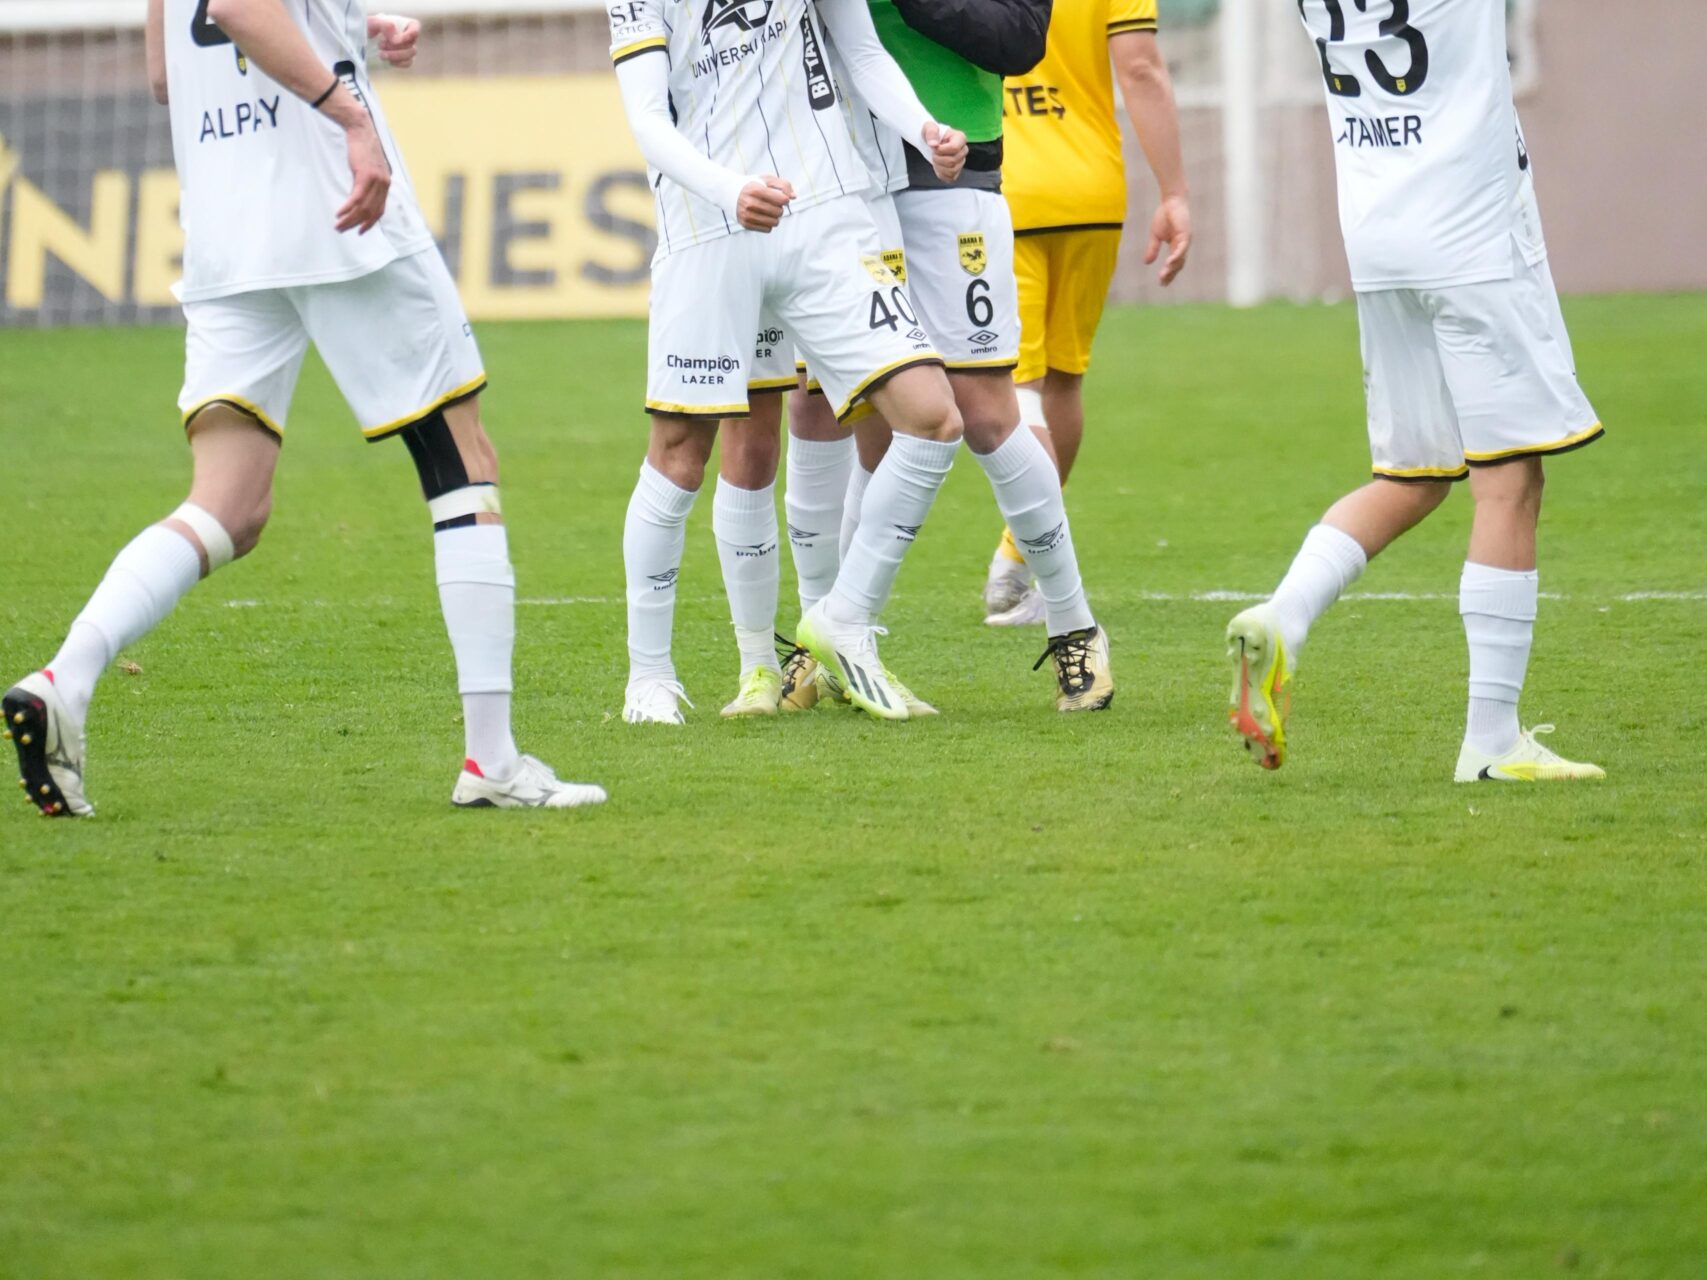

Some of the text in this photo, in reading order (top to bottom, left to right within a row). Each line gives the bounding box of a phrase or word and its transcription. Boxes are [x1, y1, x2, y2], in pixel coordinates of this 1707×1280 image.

[1003, 85, 1066, 120] TEŞ
[869, 286, 919, 332] 40
[965, 278, 994, 328] 6
[970, 345, 998, 355] umbro
[682, 374, 725, 385] LAZER
